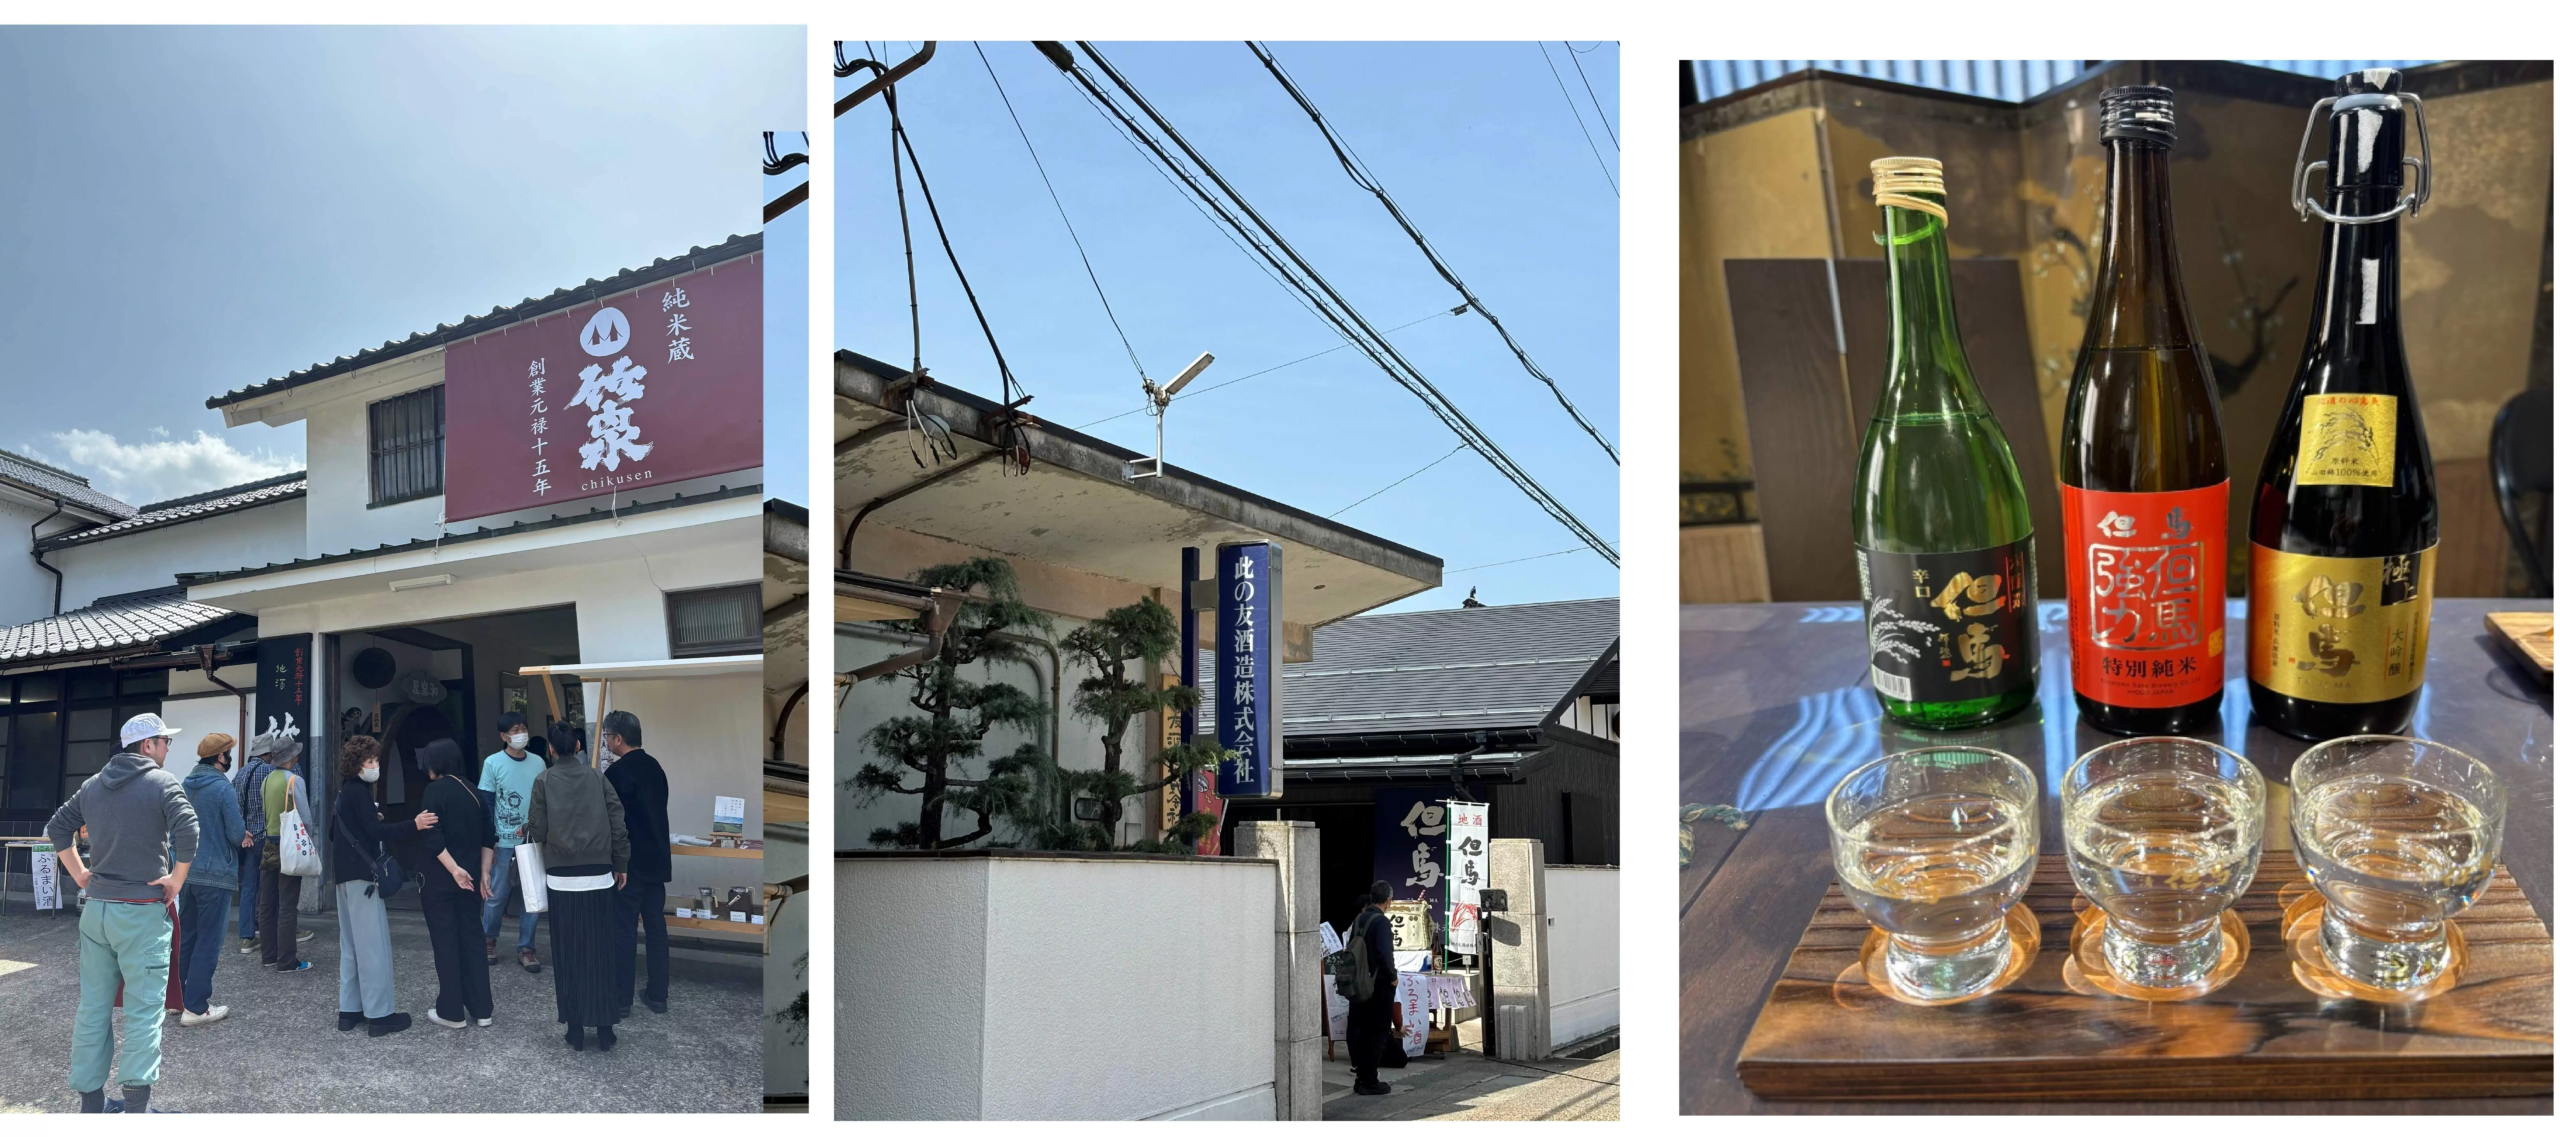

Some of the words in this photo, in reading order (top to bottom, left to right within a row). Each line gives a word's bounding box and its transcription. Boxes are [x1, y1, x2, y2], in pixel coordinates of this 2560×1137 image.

[661, 287, 695, 364] 純米蔵
[528, 357, 552, 497] 創業元禄十五年
[562, 355, 654, 472] 竹泉
[581, 468, 653, 491] chikusen
[2096, 506, 2195, 540] 但馬
[2382, 555, 2418, 606] 極上
[1930, 571, 2010, 682] 但馬
[2290, 573, 2366, 678] 但馬
[2388, 628, 2405, 677] 大吟醸
[275, 663, 288, 691] 地酒
[1233, 555, 1255, 785] 此の友酒造株式会社
[2102, 655, 2198, 679] 特別純米
[1400, 800, 1446, 888] 但馬
[1457, 813, 1482, 826] 地酒
[37, 853, 55, 907] ふるまい酒
[1457, 835, 1483, 886] 但馬
[1402, 975, 1422, 1045] ふるまい酒
